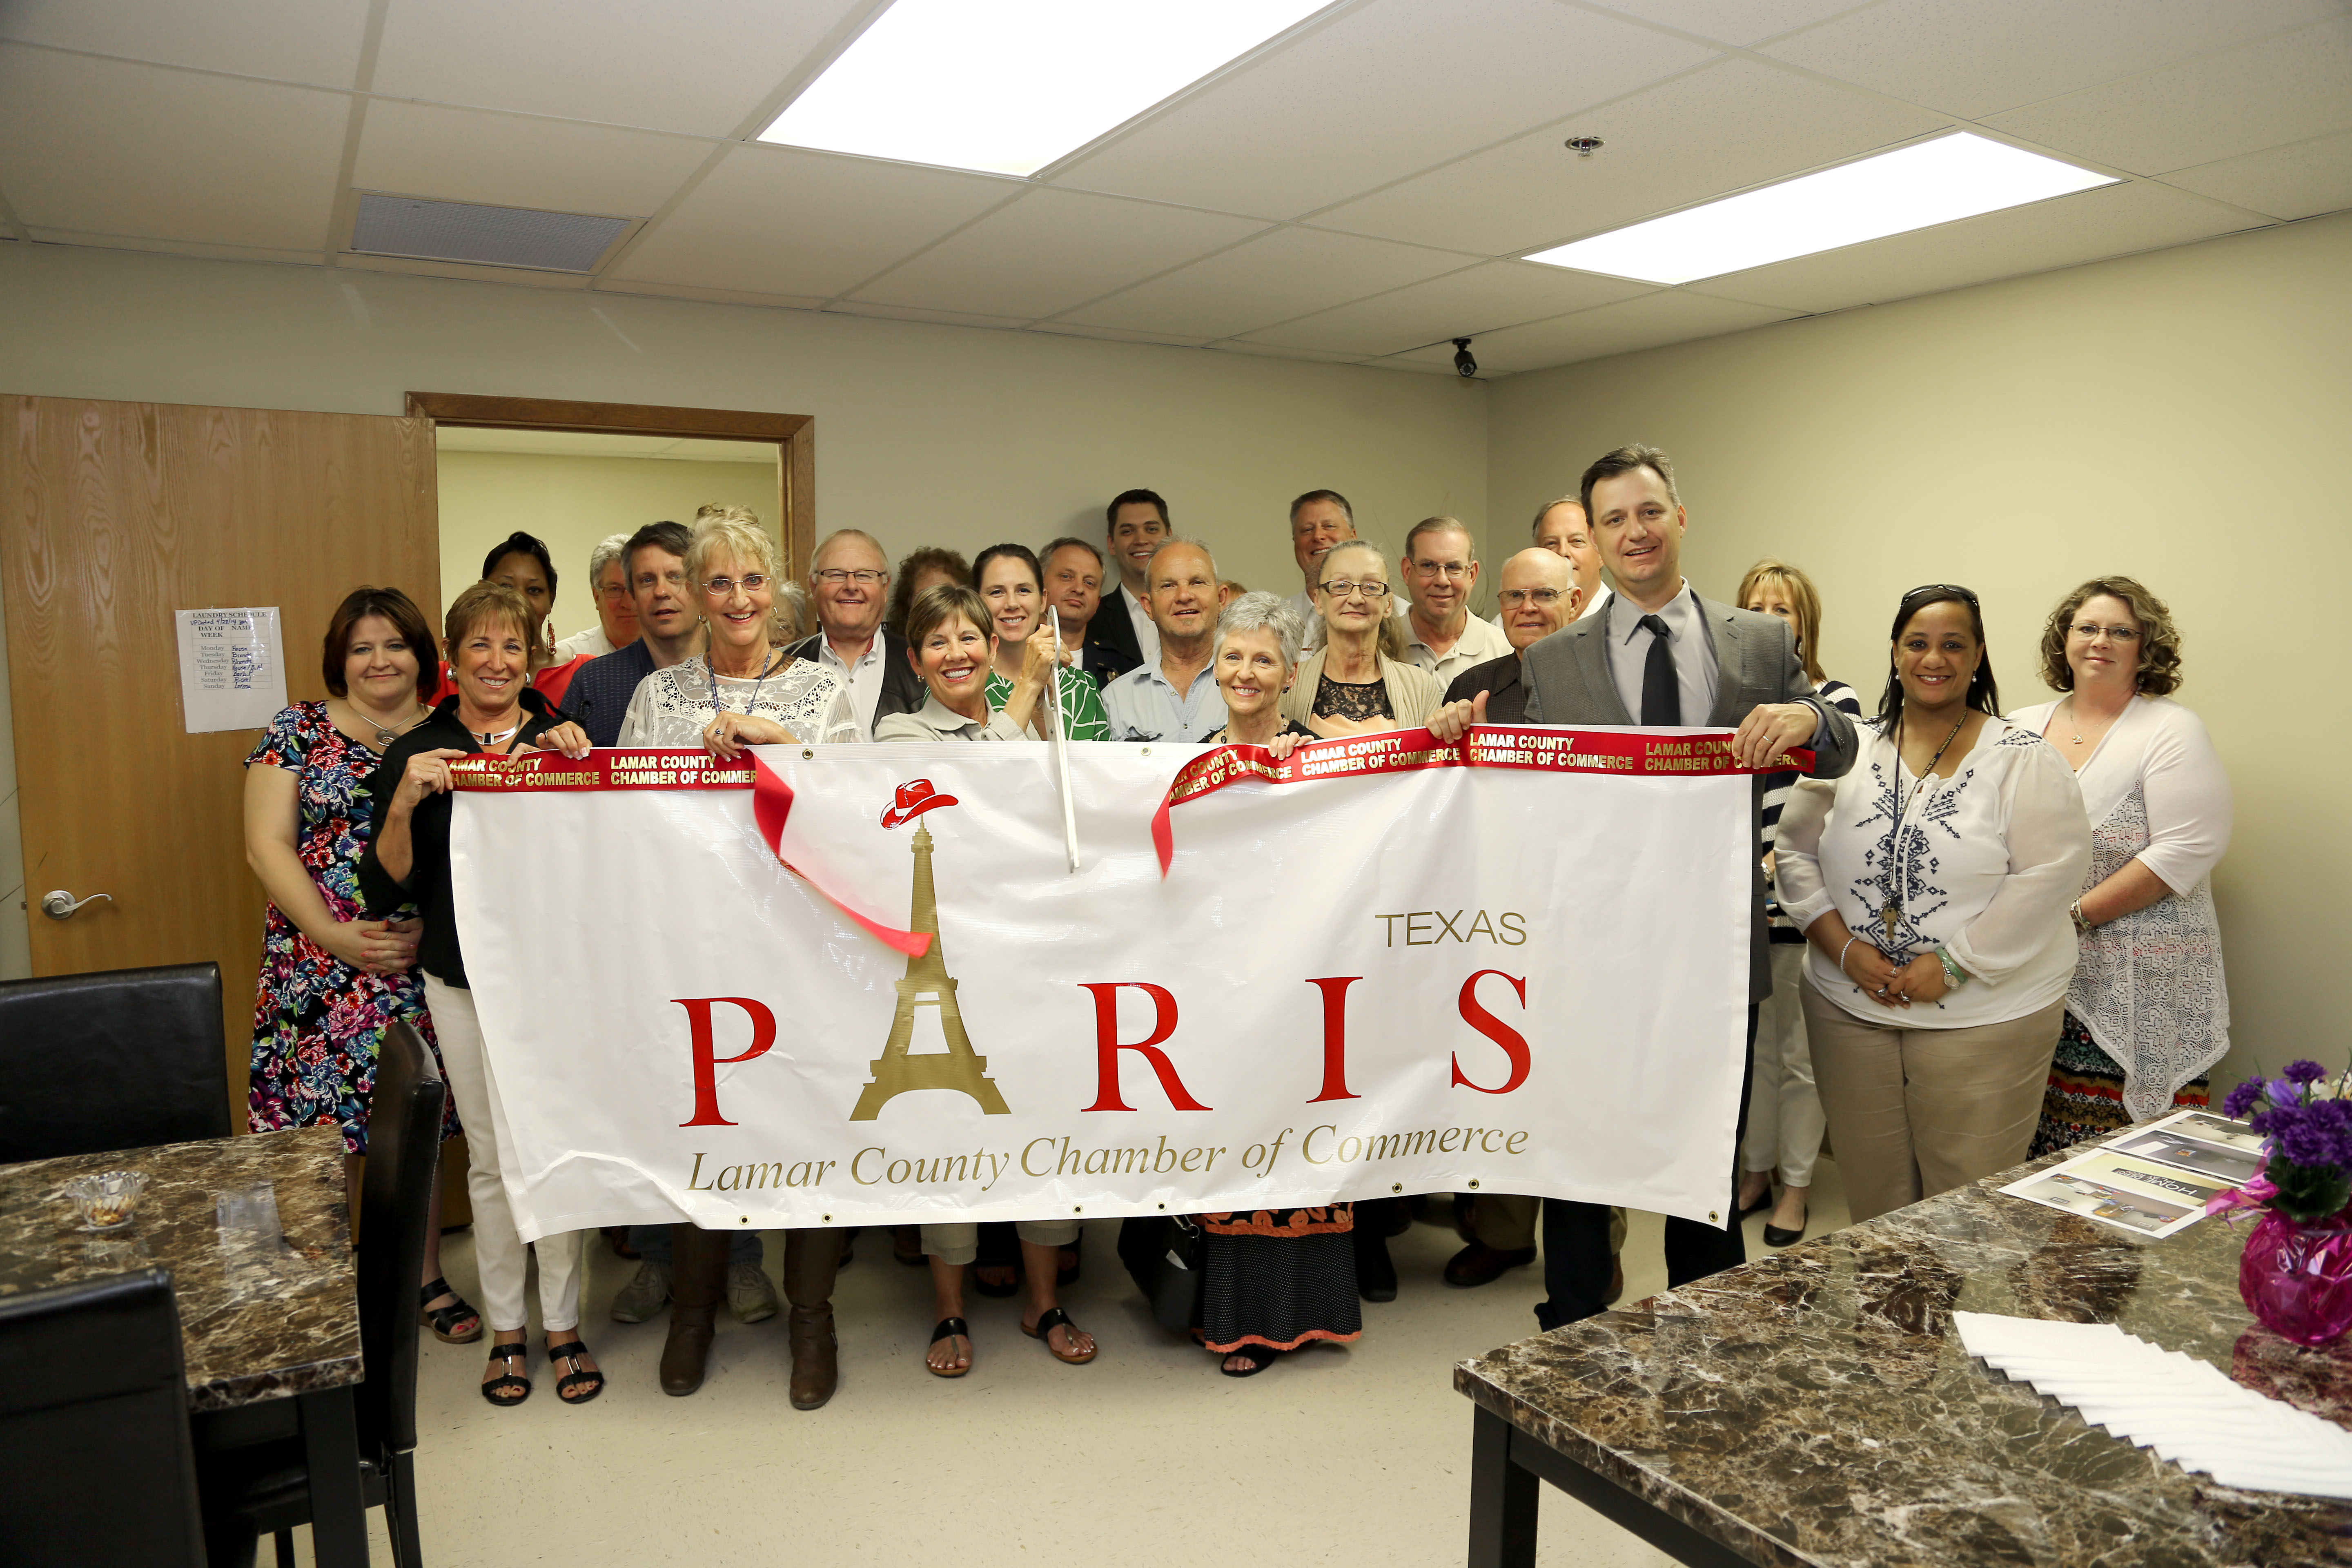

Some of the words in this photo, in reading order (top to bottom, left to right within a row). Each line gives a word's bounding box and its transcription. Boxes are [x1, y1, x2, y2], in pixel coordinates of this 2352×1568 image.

[1301, 746, 1347, 763] LAMAR
[1348, 737, 1402, 756] COUNTY
[1470, 733, 1515, 748] LAMAR
[1518, 735, 1575, 751] COUNTY
[1646, 742, 1692, 756] LAMAR
[1695, 740, 1732, 755] COUN
[449, 759, 486, 772] AMAR
[610, 755, 658, 769] LAMAR
[660, 755, 715, 769] COUNTY
[1190, 749, 1238, 777] COUNTY
[1301, 757, 1366, 776] CHAMBER
[1368, 754, 1386, 768] OF
[1389, 747, 1461, 766] COMMERCE
[1470, 748, 1533, 764] CHAMBER
[1537, 751, 1555, 766] OF
[1557, 753, 1633, 769] COMMERCE
[1645, 757, 1710, 771] CHAMBER
[1714, 756, 1730, 770] OF
[1734, 754, 1809, 769] CERCE
[453, 773, 503, 786] HAMBER
[505, 774, 523, 787] OF
[526, 771, 600, 786] COMMERCE
[610, 771, 677, 785] CHAMBER
[679, 770, 698, 784] OF
[701, 770, 757, 784] COMMER
[1169, 776, 1210, 802] AMBER
[1210, 768, 1226, 785] OF
[1228, 760, 1293, 780] COMMERCE
[1375, 910, 1527, 947] TEXAS
[684, 1152, 836, 1191] Lamar
[851, 1147, 1009, 1192] County
[1020, 1135, 1226, 1177] Chamber
[1242, 1128, 1294, 1178] of
[1303, 1124, 1529, 1165] Commerce
[2114, 1170, 2144, 1180] DEPOT
[2144, 1178, 2198, 1196] HOME
